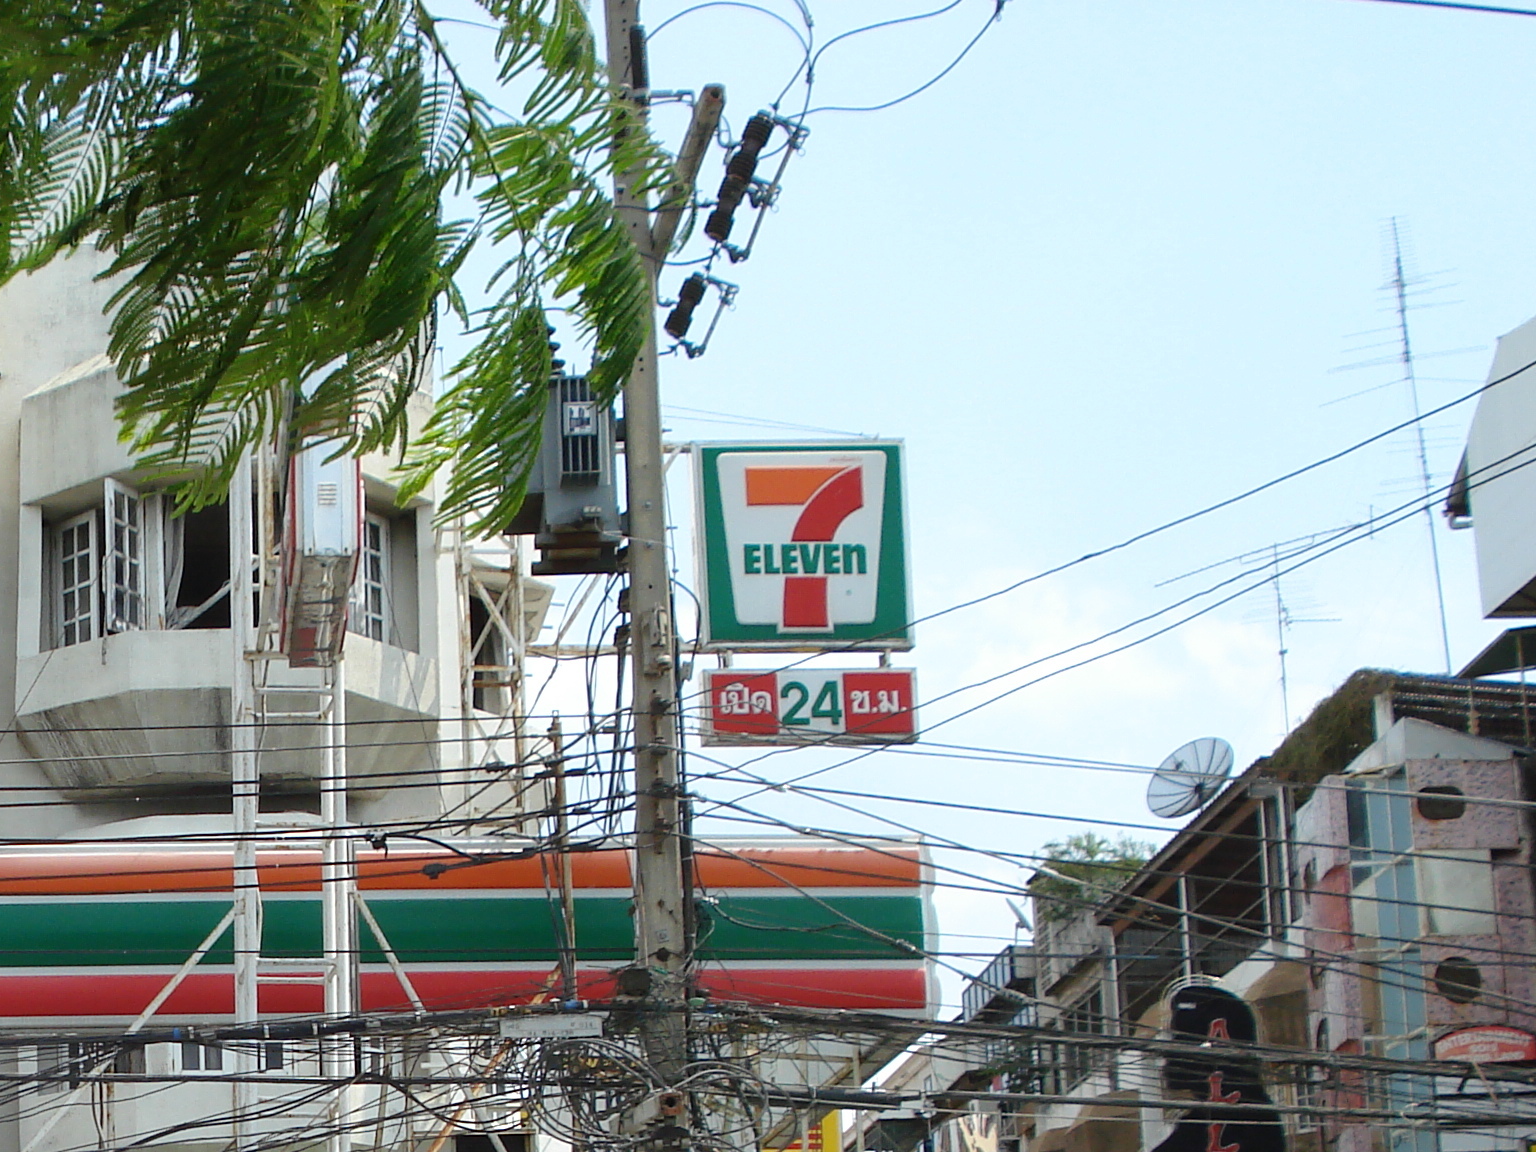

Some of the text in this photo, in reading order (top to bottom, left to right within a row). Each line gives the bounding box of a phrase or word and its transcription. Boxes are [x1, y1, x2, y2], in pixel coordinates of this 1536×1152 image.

[745, 464, 864, 628] 7
[720, 683, 772, 715] เปิด
[780, 680, 842, 726] 24
